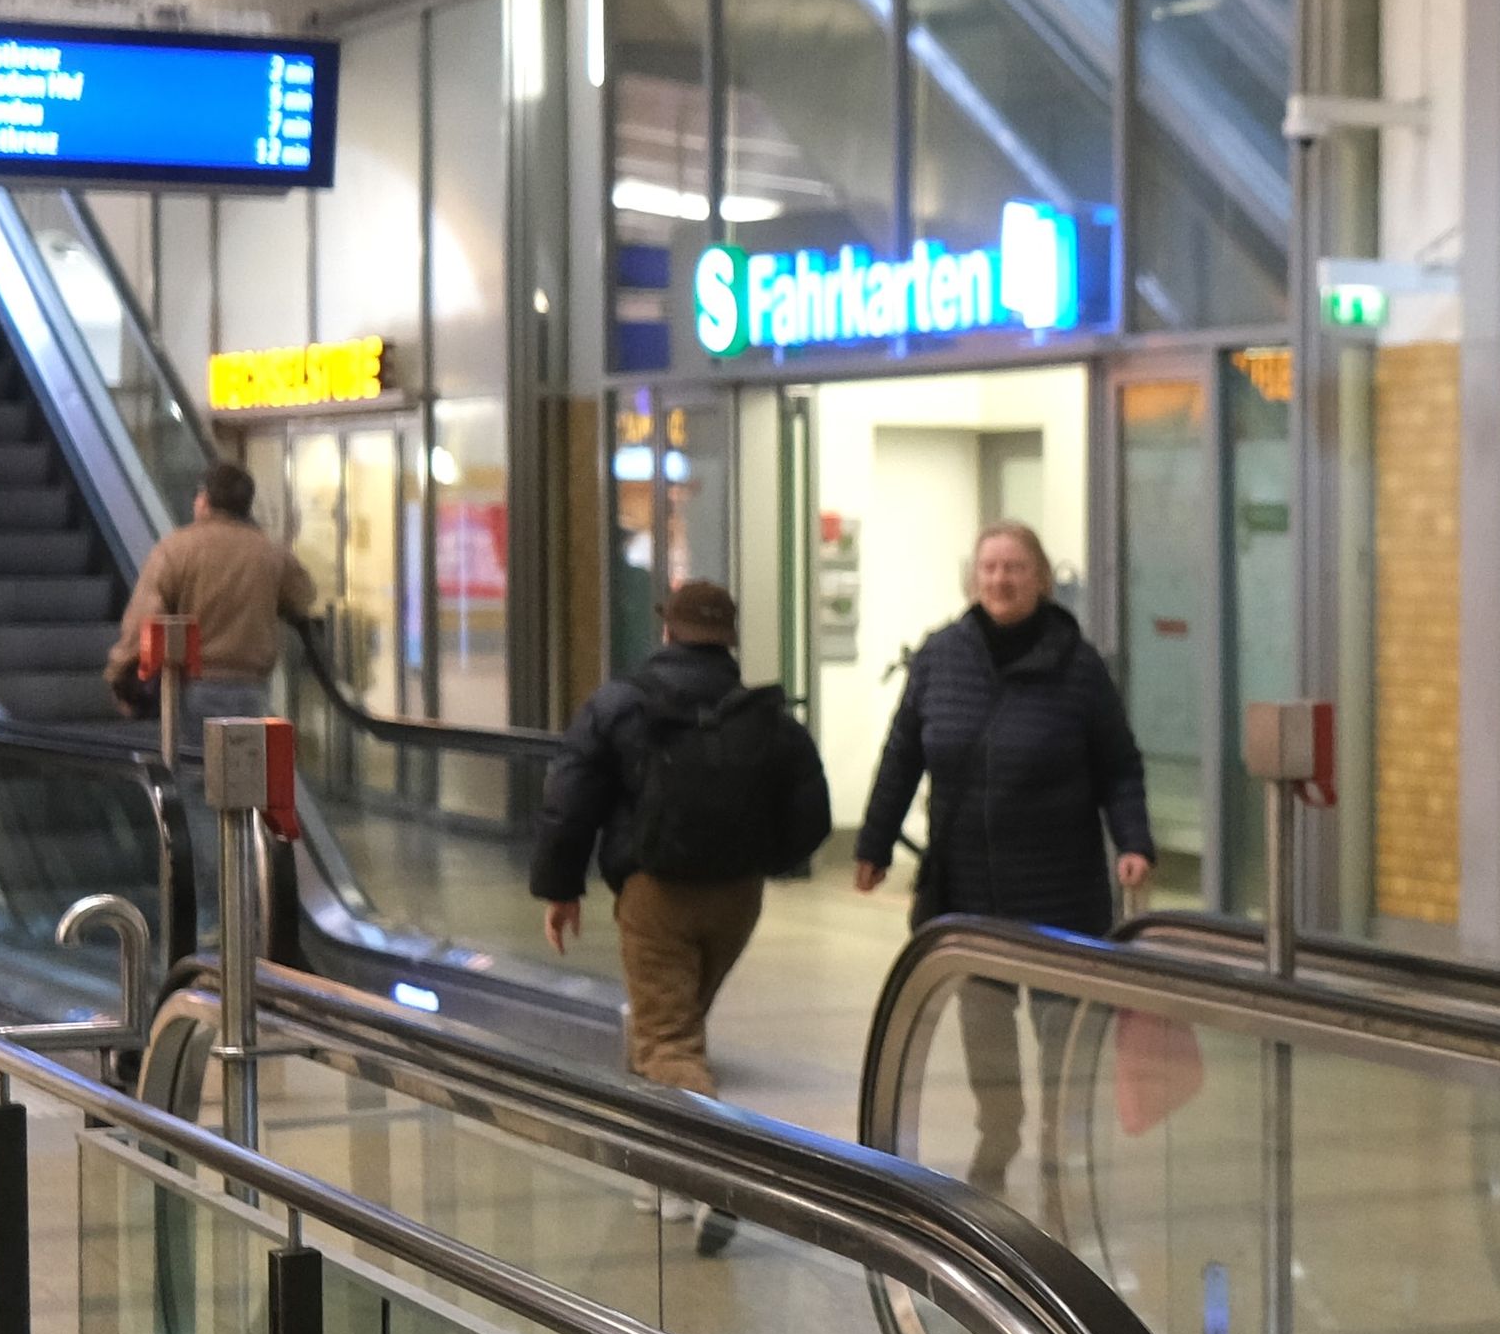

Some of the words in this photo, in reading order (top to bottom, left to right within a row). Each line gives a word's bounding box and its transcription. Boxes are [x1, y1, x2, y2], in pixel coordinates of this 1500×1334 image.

[284, 61, 313, 85] min
[283, 88, 312, 112] min
[282, 115, 312, 139] min
[281, 143, 311, 167] min
[748, 238, 994, 346] Fahrkarten
